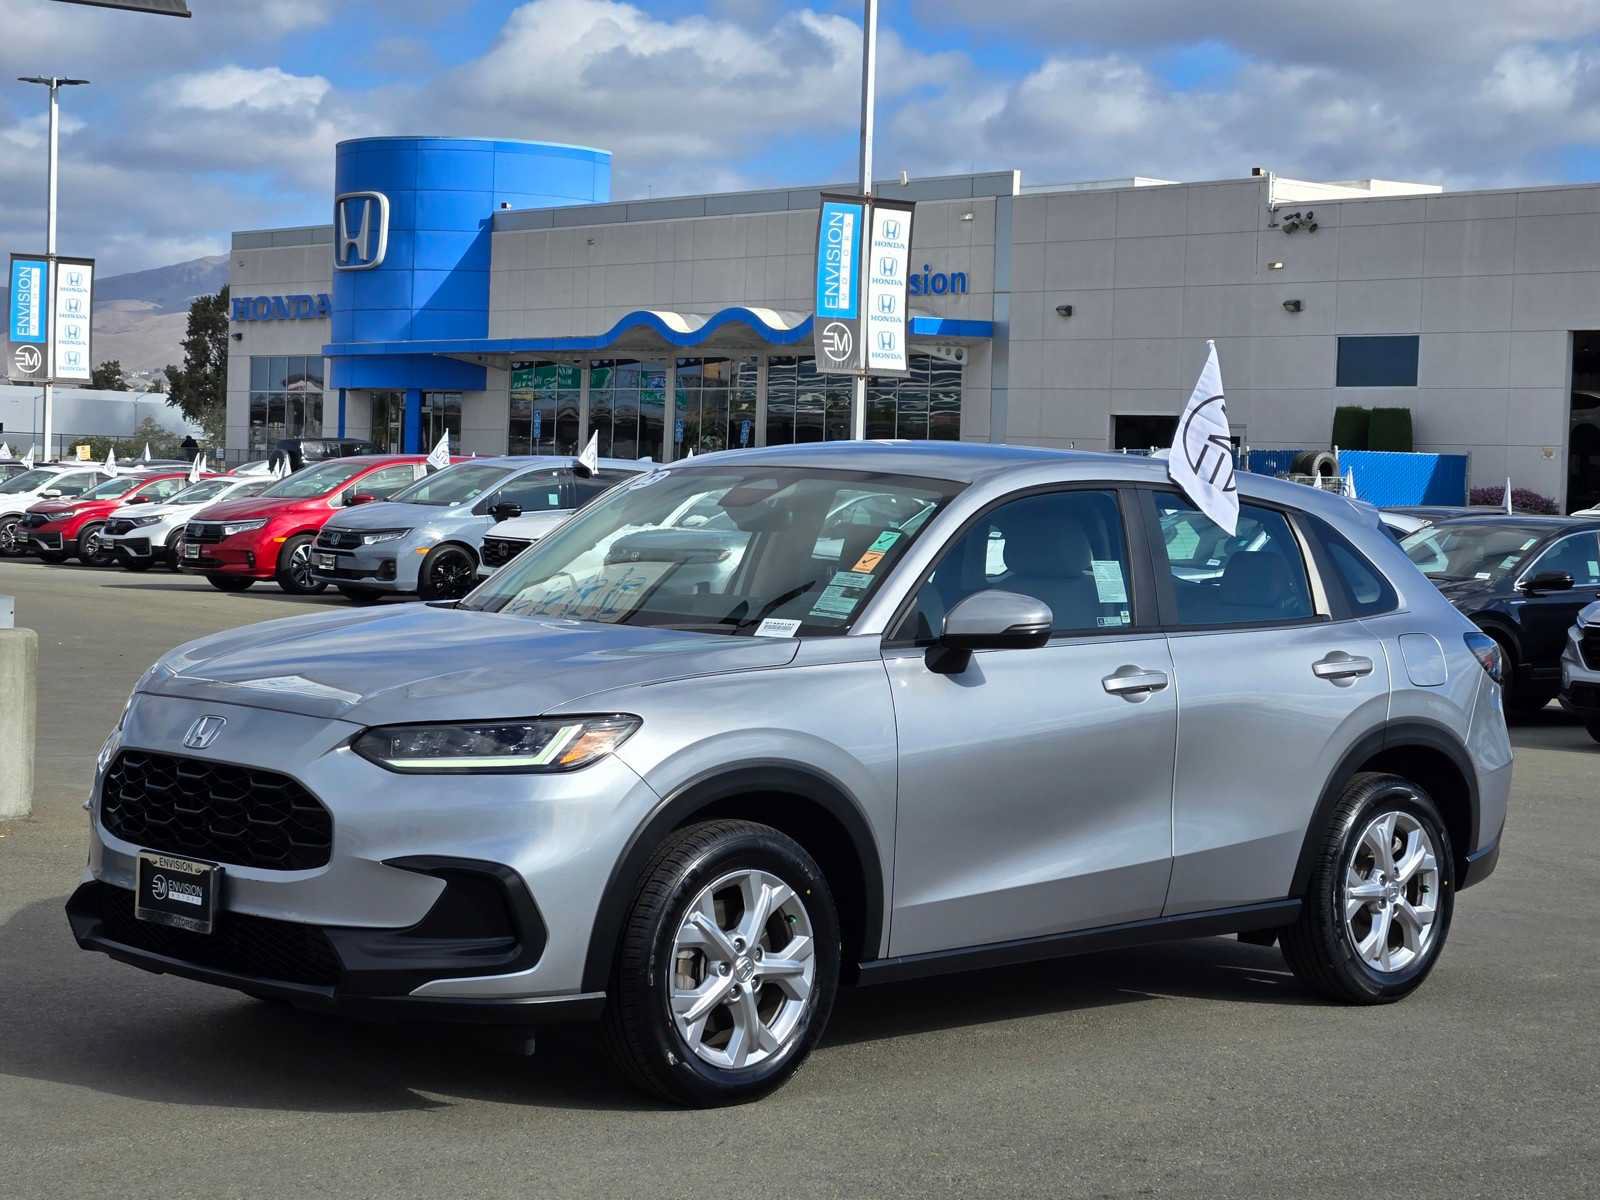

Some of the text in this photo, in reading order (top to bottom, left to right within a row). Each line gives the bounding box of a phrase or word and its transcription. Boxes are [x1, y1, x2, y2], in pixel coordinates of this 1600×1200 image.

[874, 240, 905, 250] HONDA
[824, 211, 845, 310] ENVISION
[872, 277, 903, 286] HONDA
[909, 264, 968, 296] sion
[17, 266, 32, 336] ENVISION
[231, 293, 332, 321] HONDA
[870, 314, 902, 323] HONDA
[871, 351, 903, 361] HONDA
[159, 857, 193, 872] ENVISION
[168, 880, 203, 897] ENVISION
